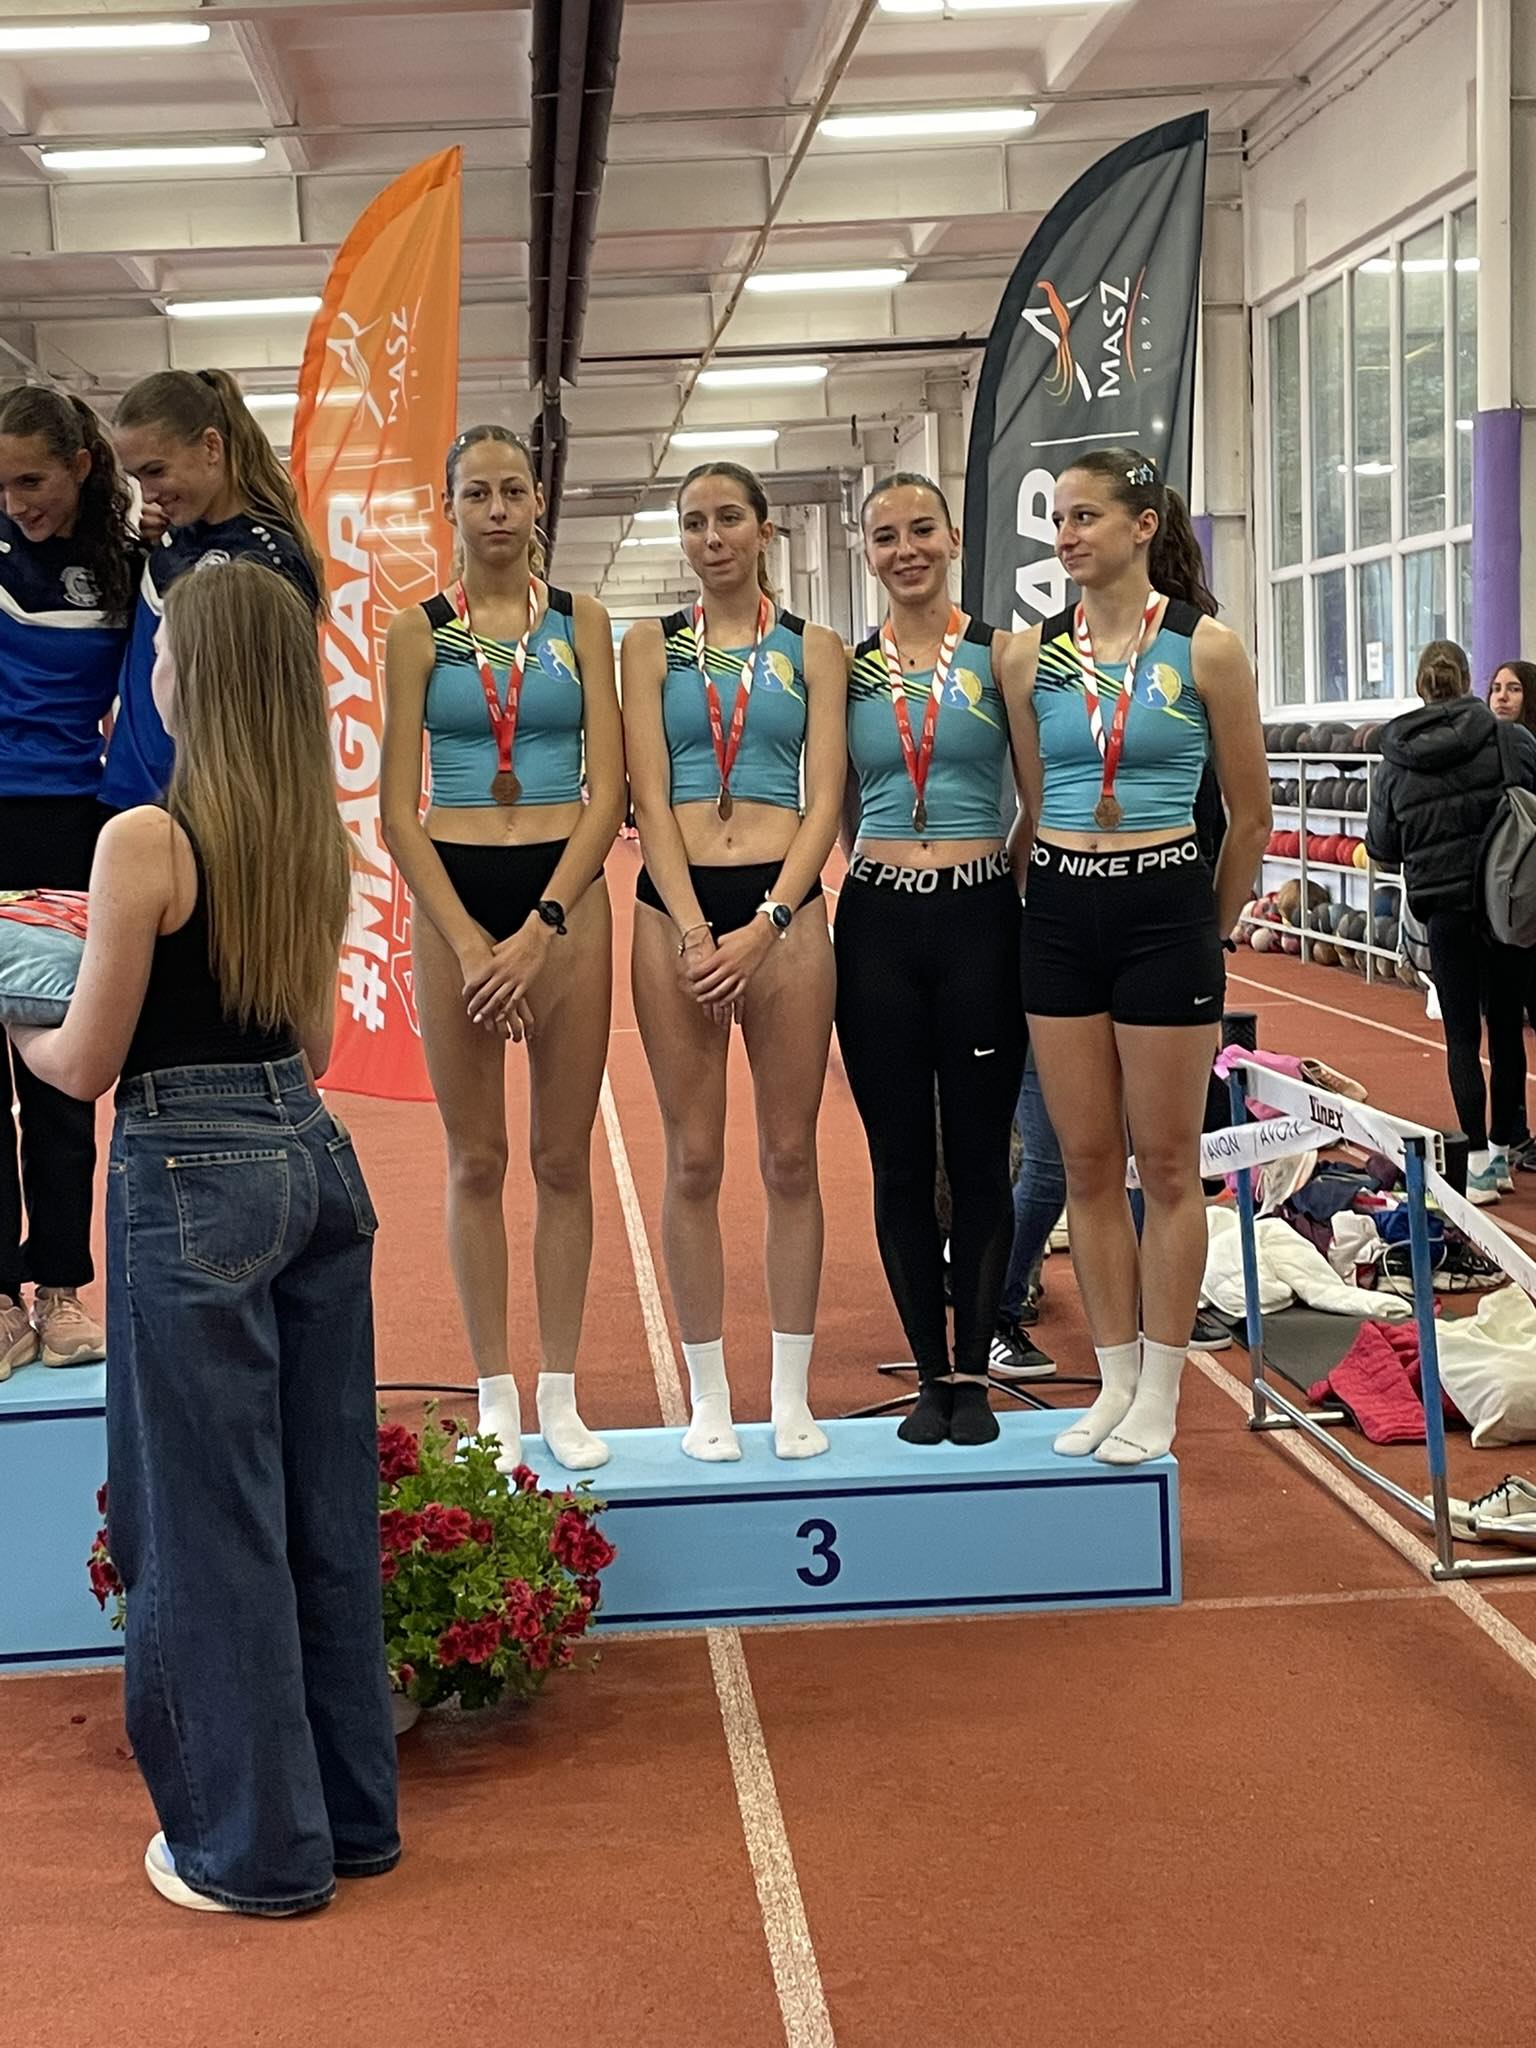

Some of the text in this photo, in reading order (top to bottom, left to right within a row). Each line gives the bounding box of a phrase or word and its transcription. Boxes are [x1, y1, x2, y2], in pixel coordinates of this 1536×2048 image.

[386, 305, 408, 425] MASZ
[1097, 276, 1130, 397] MASZ
[875, 864, 939, 894] PRO
[952, 849, 1011, 890] NIKE
[1058, 854, 1130, 877] NIKE
[1137, 841, 1198, 874] PRO
[1206, 1133, 1242, 1161] AVON
[796, 1518, 841, 1587] 3
